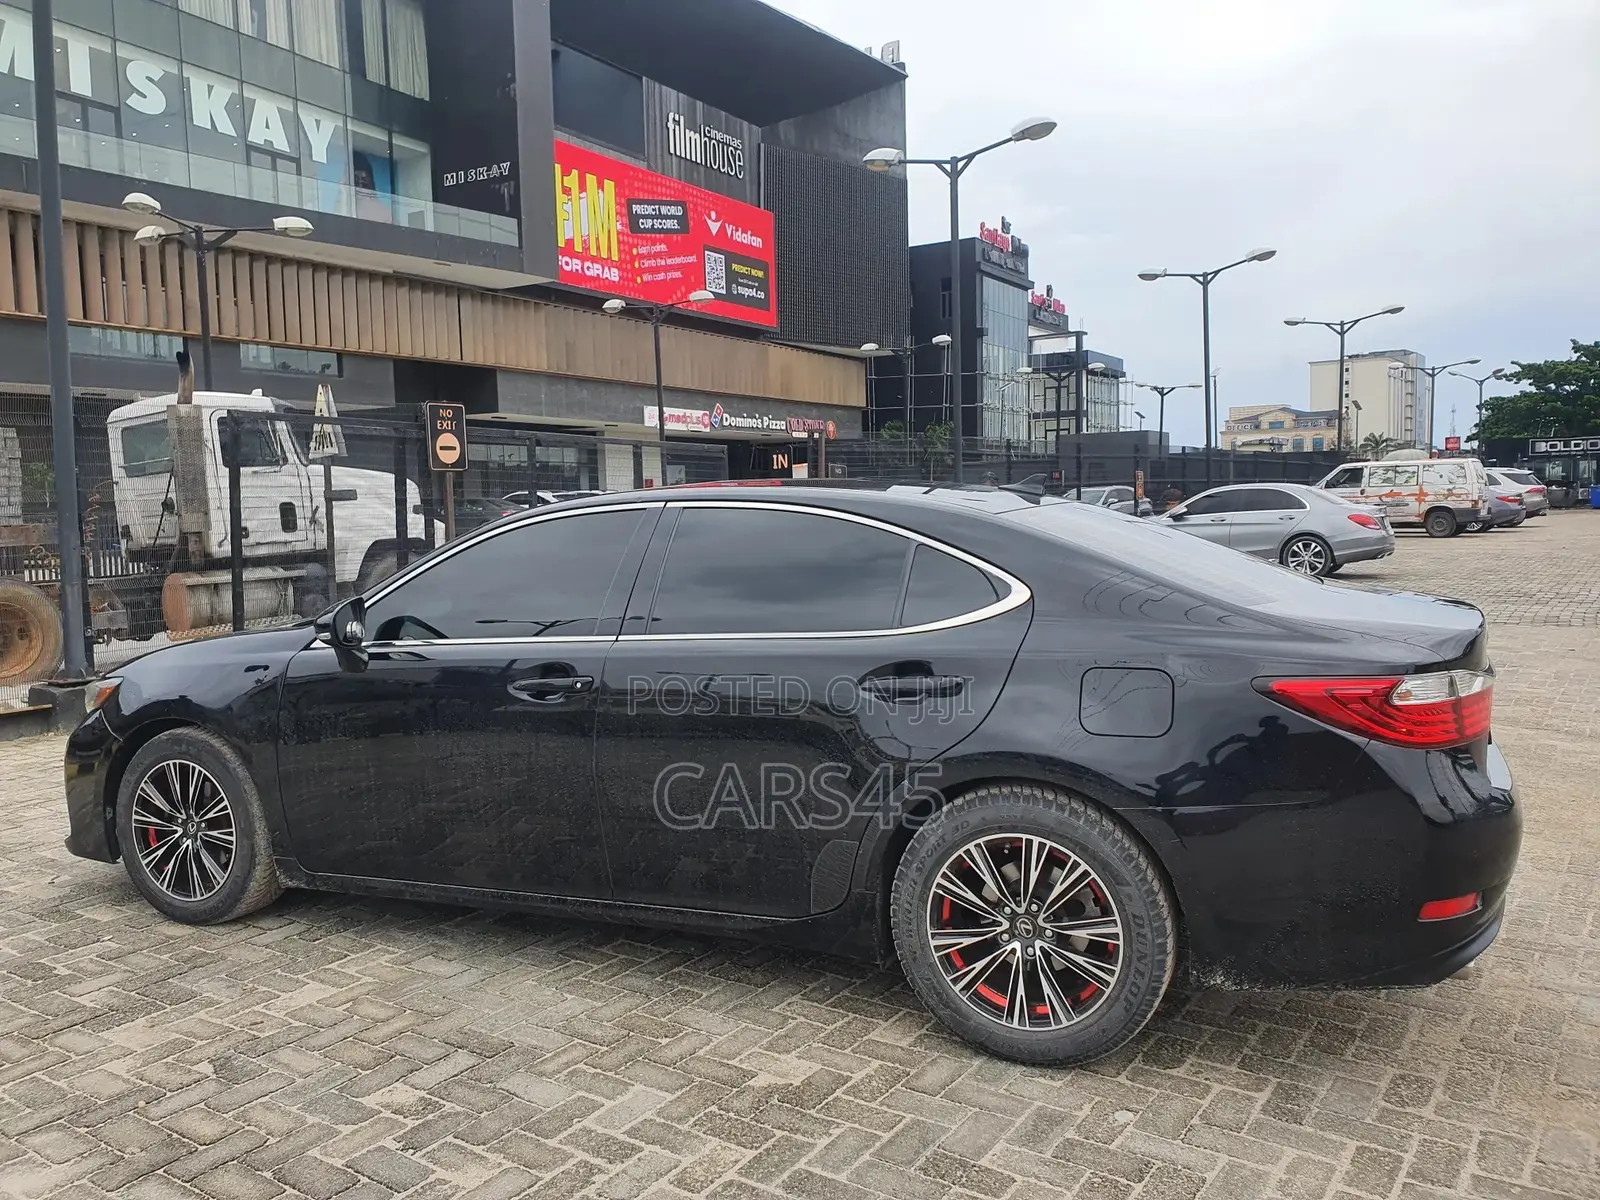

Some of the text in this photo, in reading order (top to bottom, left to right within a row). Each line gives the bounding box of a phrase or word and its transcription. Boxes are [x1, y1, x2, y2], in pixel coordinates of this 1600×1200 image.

[667, 112, 744, 179] filmhouse
[705, 125, 743, 150] cinemas
[444, 161, 511, 187] MISKAY
[632, 204, 683, 216] PREDICT WORLD
[638, 218, 681, 229] CUP SCORES.
[725, 222, 763, 249] Vidafan
[558, 254, 620, 282] OR GRAB
[640, 257, 657, 268] Climb
[657, 257, 666, 266] the
[731, 263, 751, 275] PREDICT
[642, 273, 653, 282] Win
[439, 408, 453, 418] NO
[722, 413, 786, 430] Domino's Pizza
[437, 420, 457, 431] EXIT
[772, 453, 788, 470] IN
[1123, 911, 1149, 1014] DUNLOP
